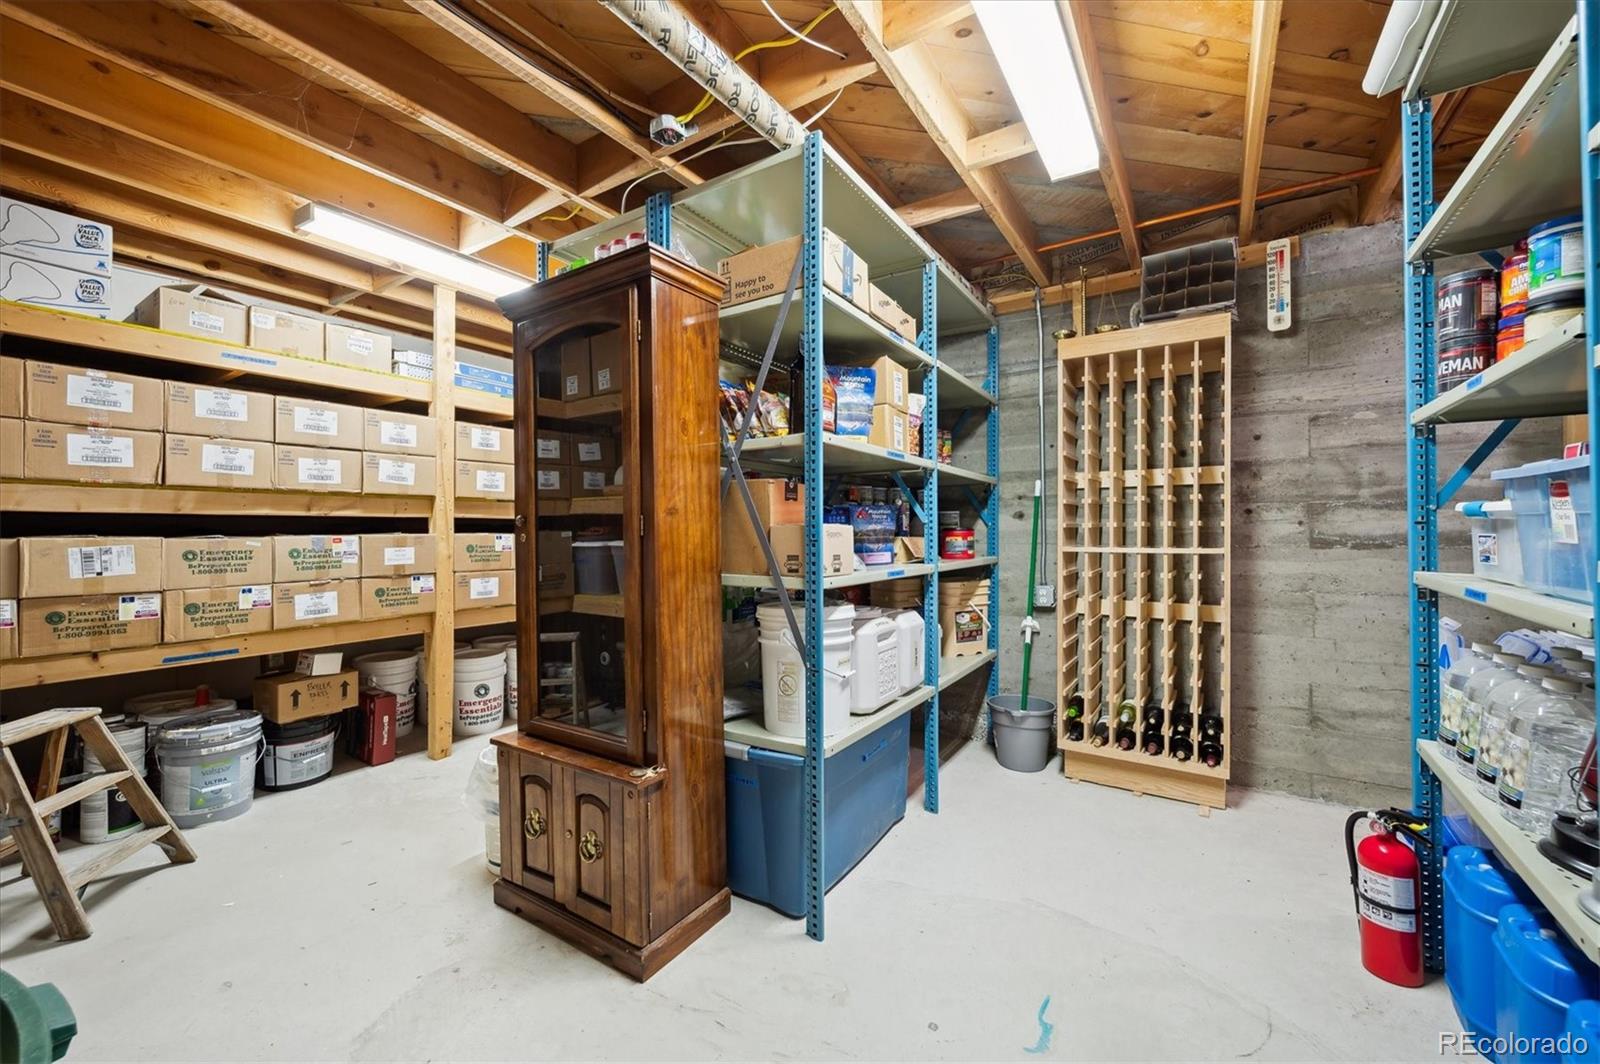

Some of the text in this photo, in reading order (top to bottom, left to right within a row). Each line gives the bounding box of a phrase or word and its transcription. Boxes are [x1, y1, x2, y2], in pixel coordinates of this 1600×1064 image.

[78, 228, 100, 236] VALUE
[80, 234, 99, 242] PACK
[735, 275, 767, 289] Happy to
[80, 283, 101, 291] VALUE
[735, 283, 775, 299] see you too
[839, 375, 872, 384] Mountain
[199, 554, 253, 562] Essentials
[52, 623, 128, 633] BePrepared.com
[57, 628, 127, 640] 1-800-999-1863
[204, 777, 228, 786] ULTRA
